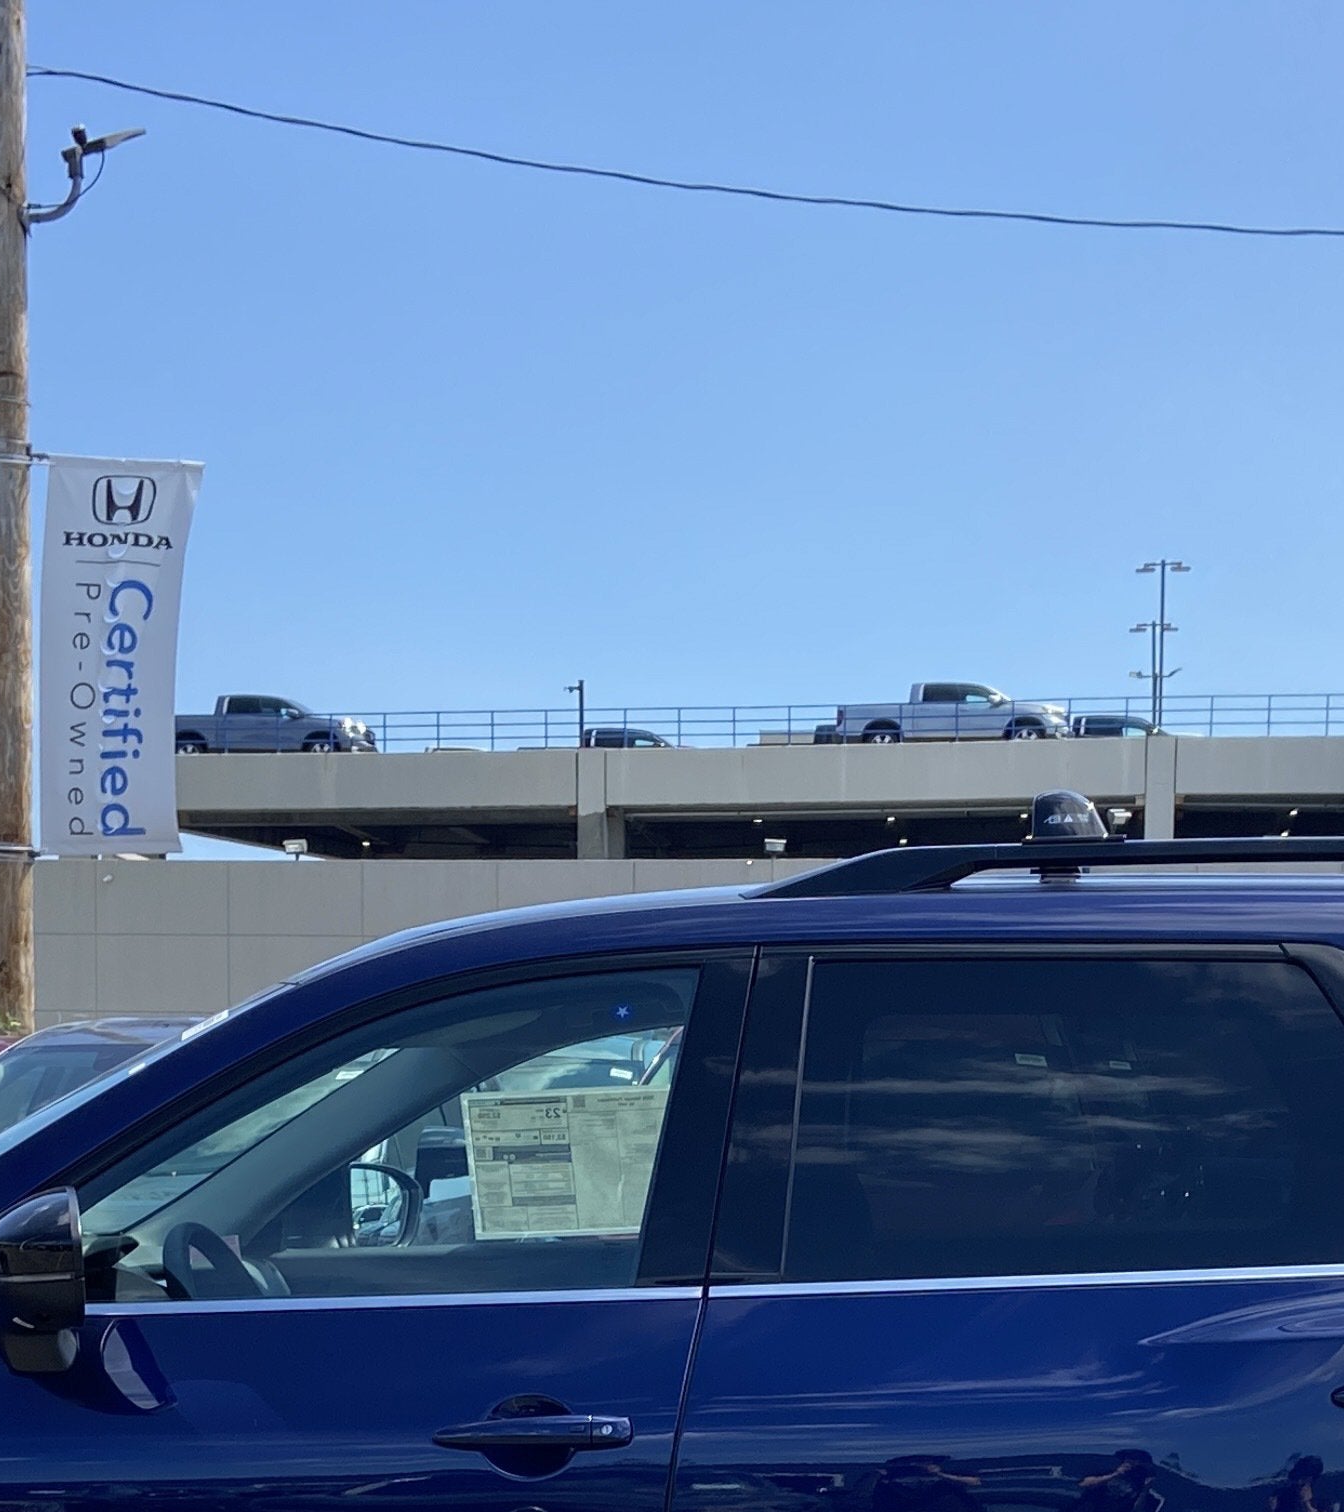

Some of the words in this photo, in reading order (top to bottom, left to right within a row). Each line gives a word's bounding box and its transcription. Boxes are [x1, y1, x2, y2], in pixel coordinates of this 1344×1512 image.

[62, 531, 173, 551] HONDA
[67, 583, 101, 836] Pre-Owned
[100, 580, 153, 838] Certified
